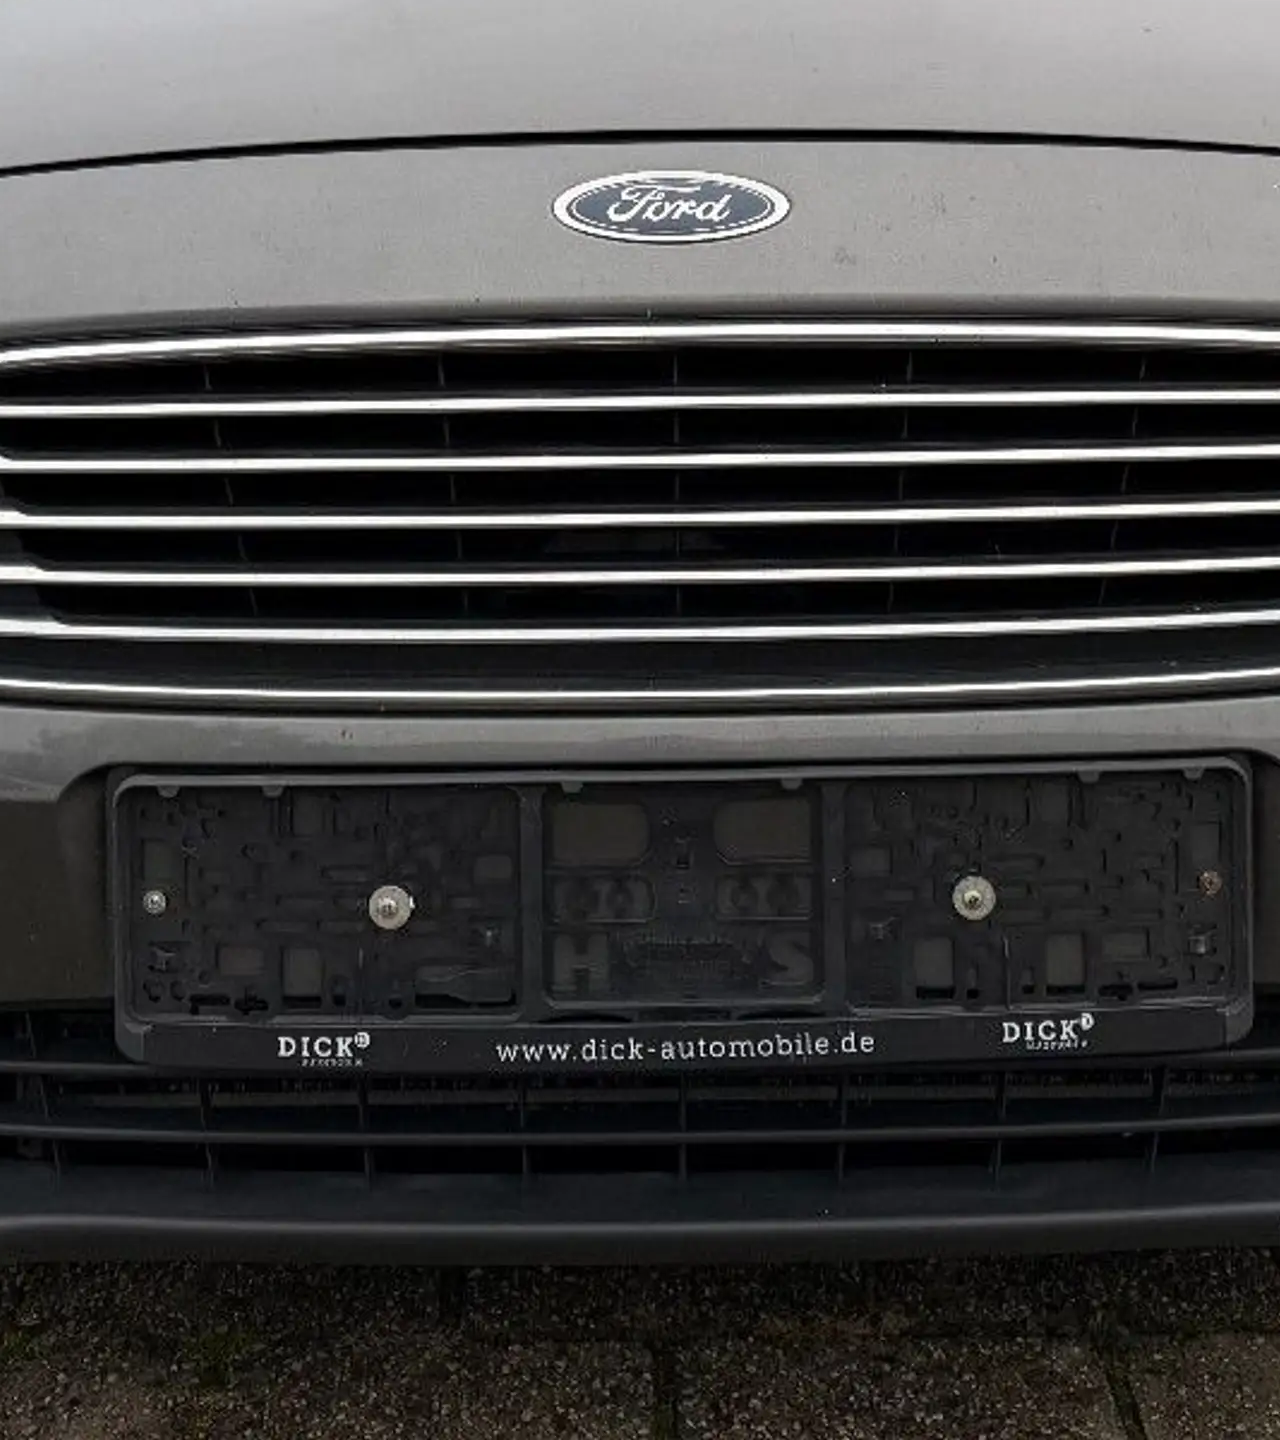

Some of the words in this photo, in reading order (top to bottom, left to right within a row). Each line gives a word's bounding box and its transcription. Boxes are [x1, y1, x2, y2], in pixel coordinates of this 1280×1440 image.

[606, 184, 732, 222] Ford
[495, 1032, 876, 1062] www.dick-automobile.de
[1001, 1019, 1077, 1049] DICK
[277, 1036, 354, 1063] DICK
